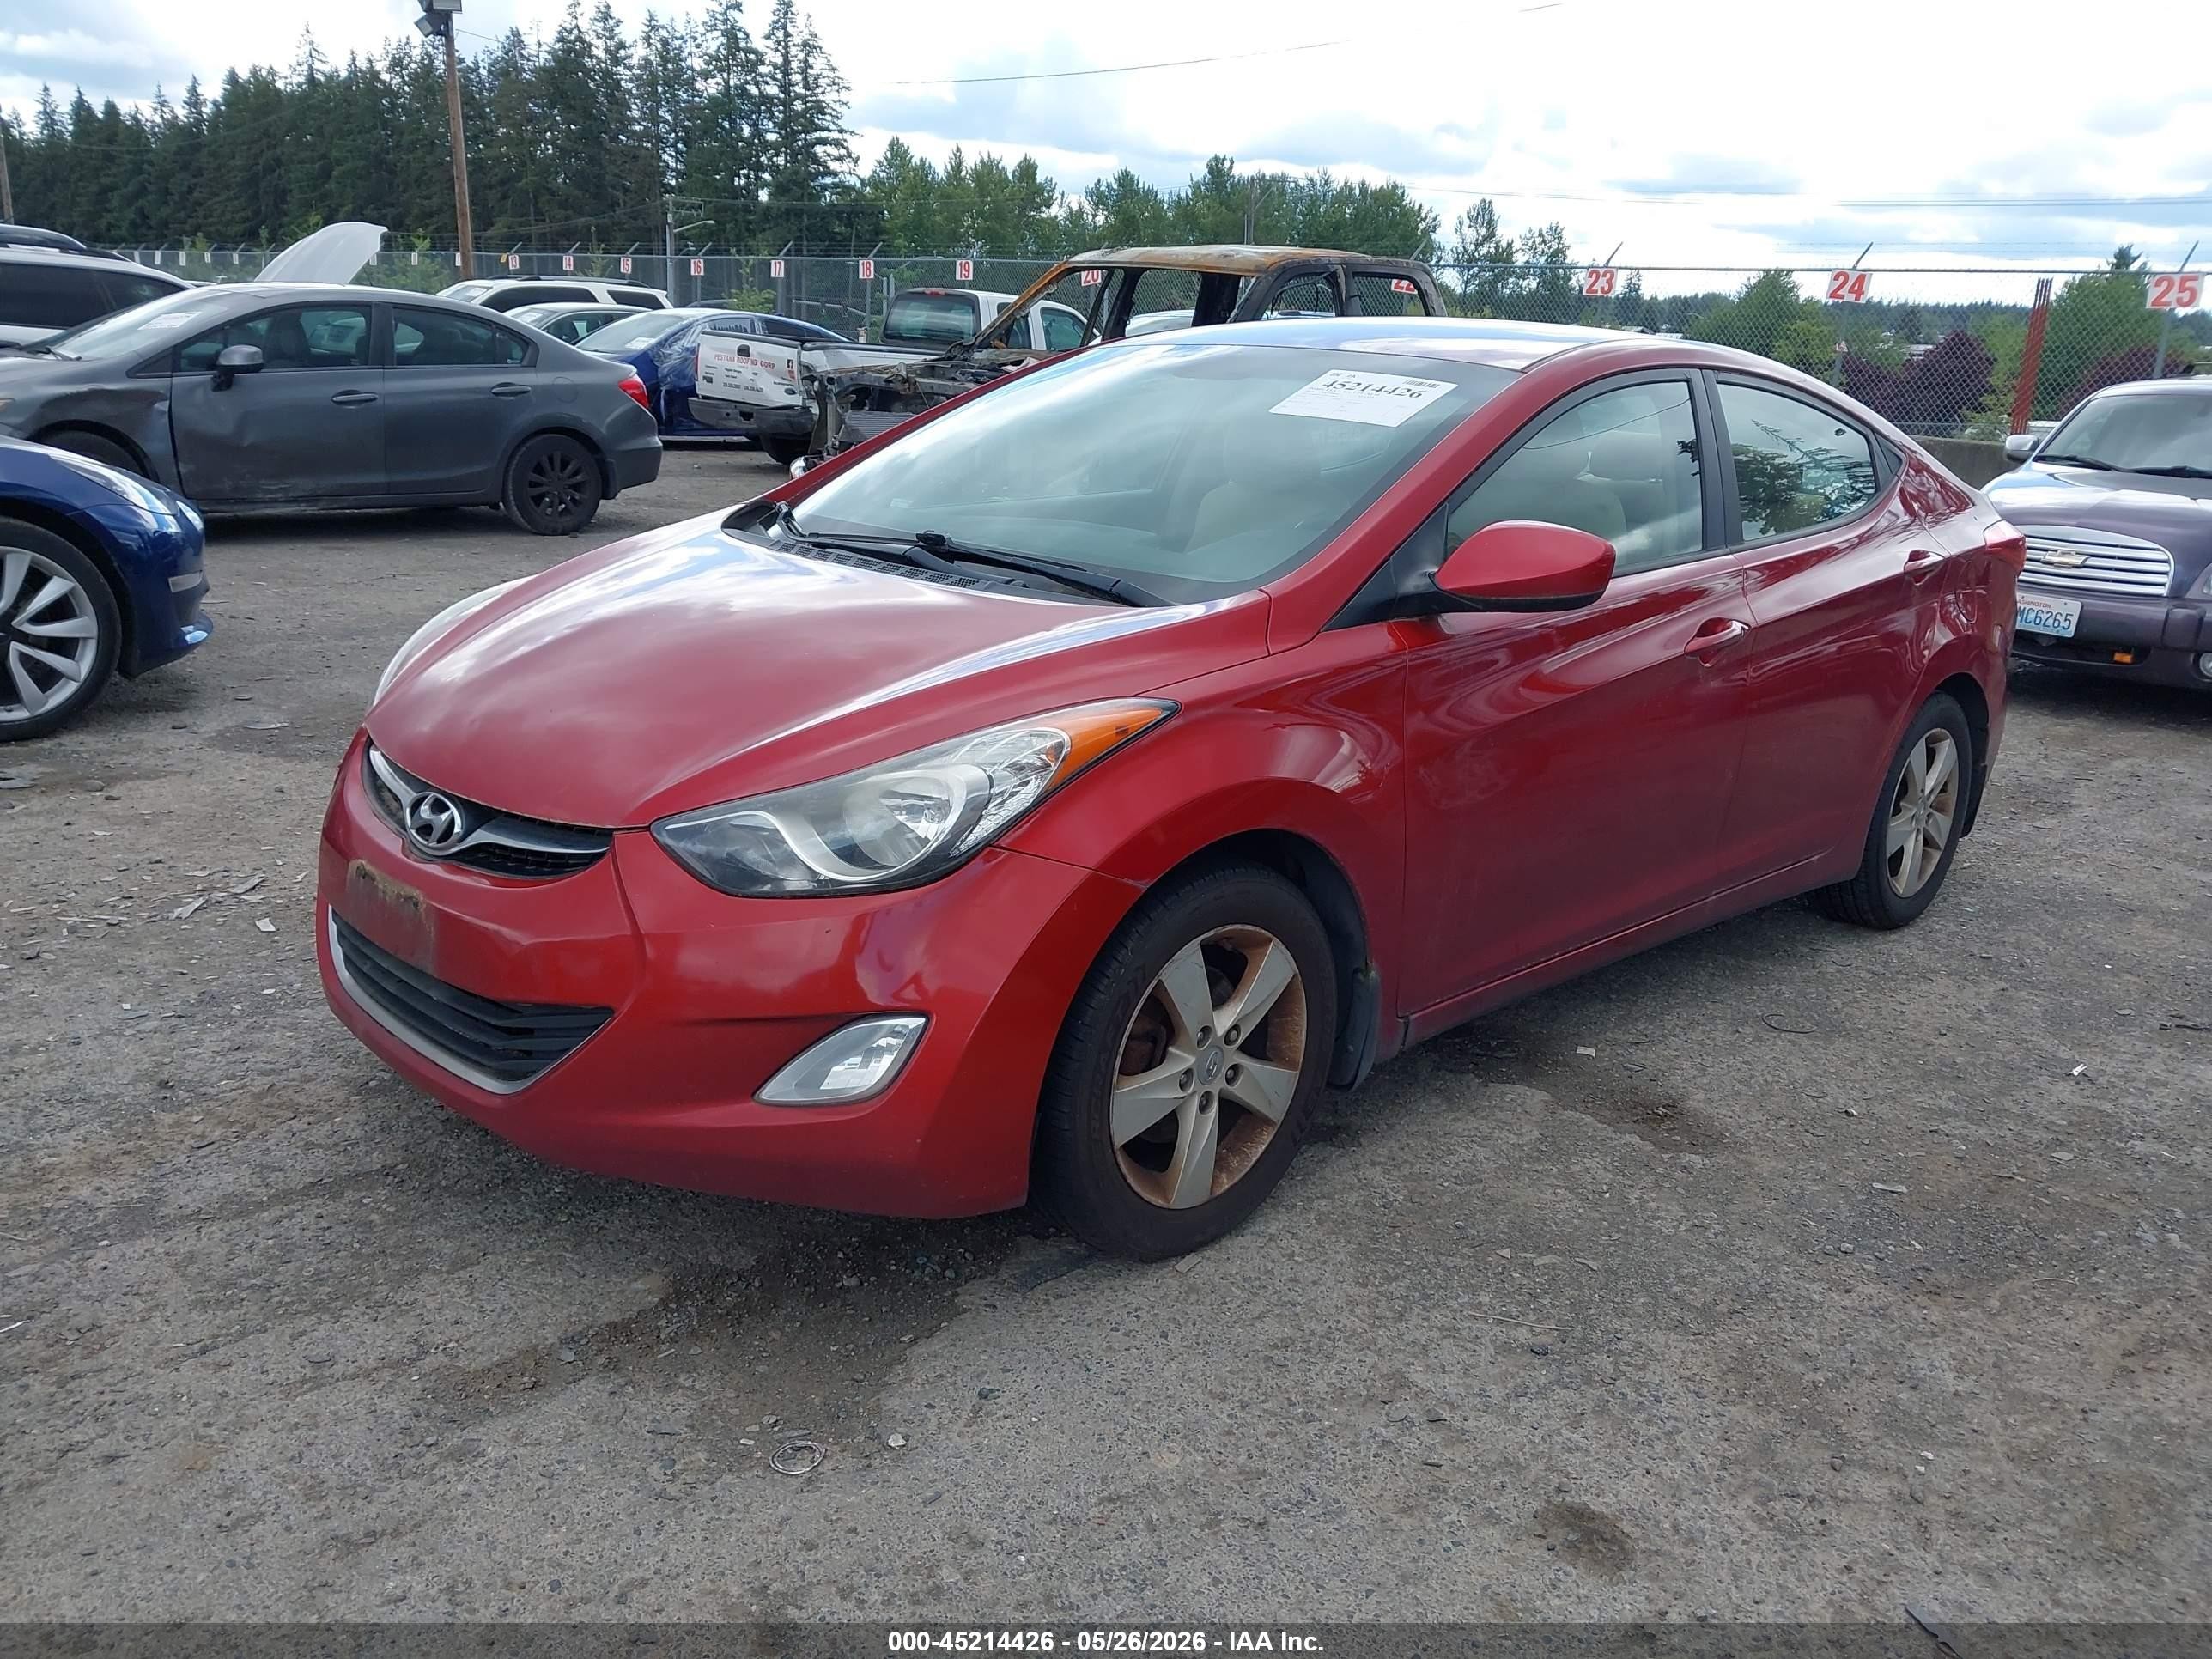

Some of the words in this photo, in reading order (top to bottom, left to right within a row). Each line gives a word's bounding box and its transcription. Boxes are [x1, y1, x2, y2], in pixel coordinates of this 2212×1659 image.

[564, 256, 572, 269] 14
[622, 258, 630, 272] 15
[693, 259, 702, 274] 16
[774, 260, 781, 276] 17
[861, 260, 872, 277] 18
[958, 260, 970, 278] 19
[1084, 270, 1099, 284] 20
[1586, 269, 1614, 295] 23
[1829, 270, 1866, 301] 24
[2150, 275, 2199, 307] 25
[737, 356, 757, 366] ROOFING
[760, 360, 775, 370] CORP
[1322, 380, 1427, 398] 45214426
[2018, 599, 2052, 609] ASHINGTON
[2019, 606, 2074, 630] MC6265
